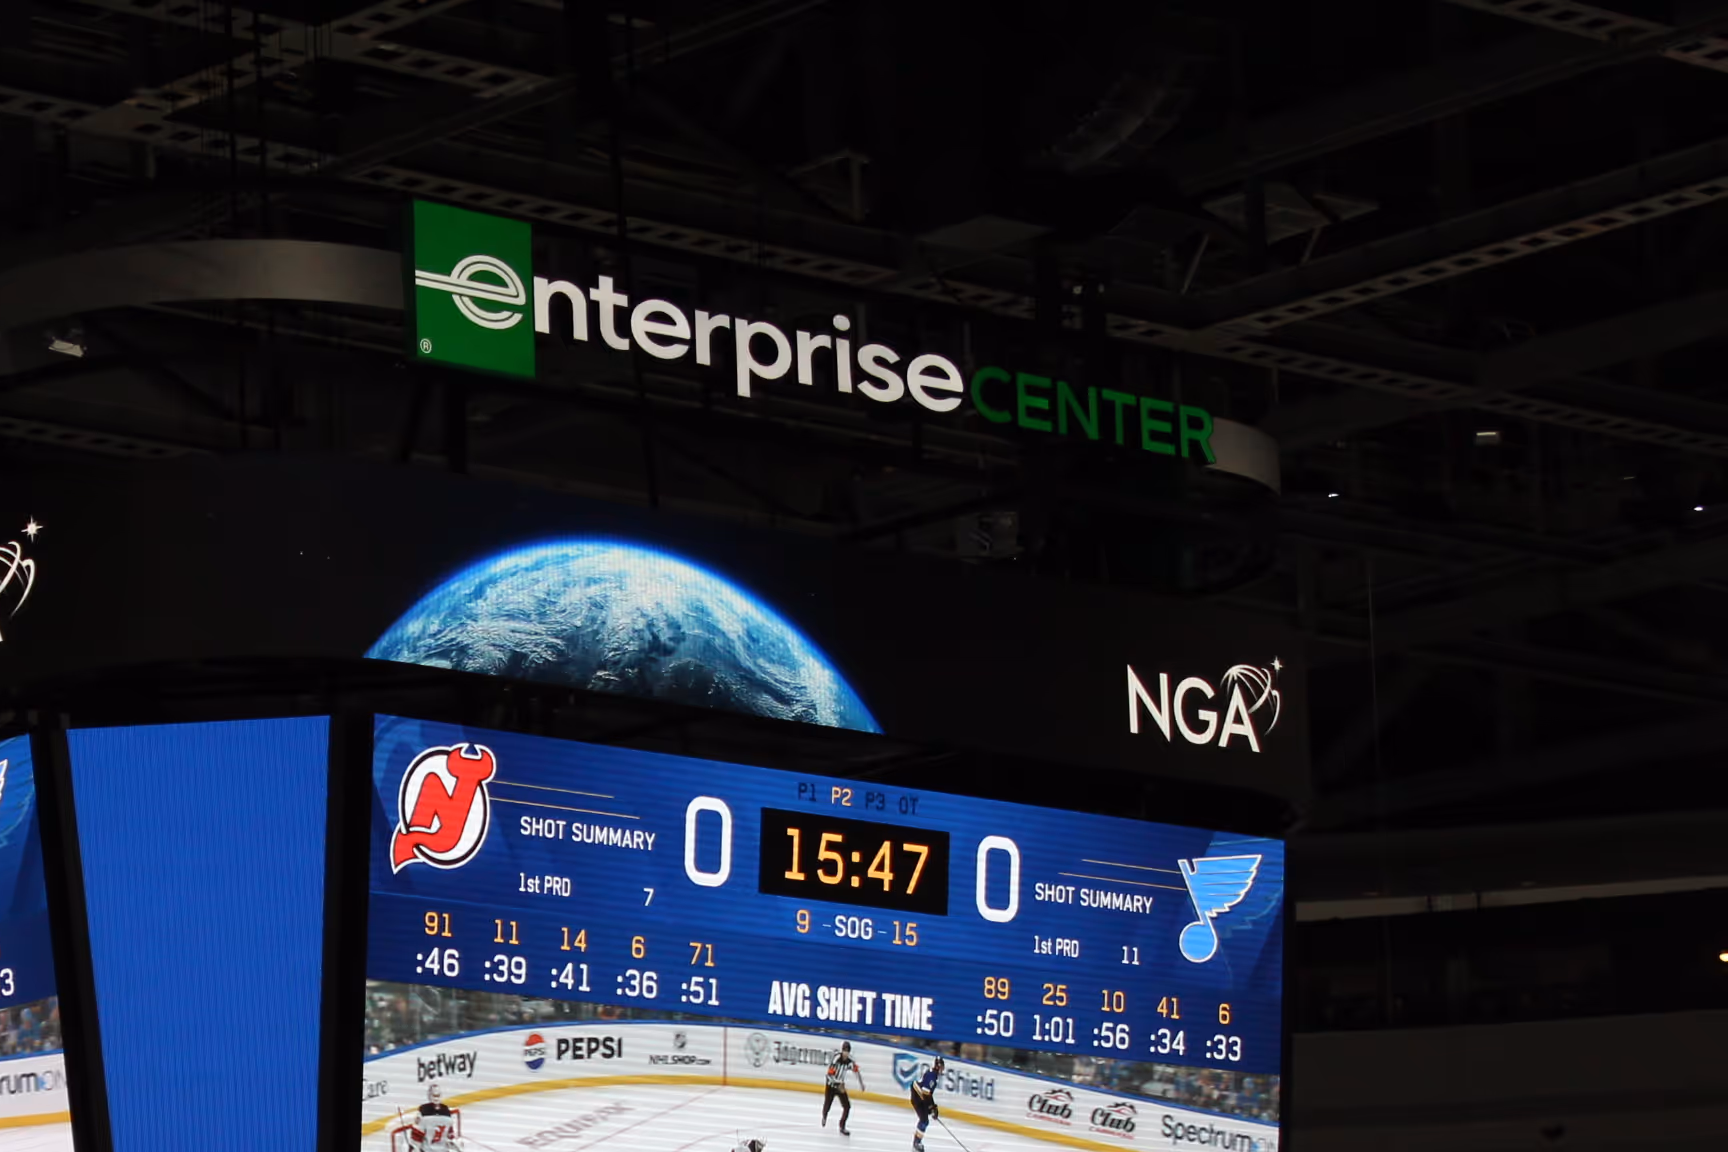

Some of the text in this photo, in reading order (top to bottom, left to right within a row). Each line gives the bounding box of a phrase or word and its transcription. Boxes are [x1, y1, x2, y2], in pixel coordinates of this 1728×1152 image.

[415, 254, 1216, 464] enterprise CENTER
[1127, 664, 1261, 753] NGA
[797, 782, 817, 802] P1
[831, 786, 853, 806] P2
[865, 791, 885, 811] P3
[520, 815, 656, 852] SHOT SUMMARY
[684, 794, 733, 888] 0
[784, 827, 929, 895] 15:47
[975, 834, 1021, 924] 0
[518, 871, 572, 898] 1st PRD
[642, 888, 655, 907] 7
[1034, 881, 1154, 916] SHOT SUMMARY
[423, 912, 716, 968] 91 11 14 6 71
[796, 909, 810, 934] 9
[892, 920, 918, 947] 15
[1033, 934, 1080, 959] 1st PRD
[1121, 945, 1140, 966] 11
[415, 947, 720, 1007] :46 :39 :41 :36 :51
[767, 980, 933, 1032] AVG SHIFT TIME
[983, 976, 1231, 1025] 89 25 10 41 6
[556, 1036, 622, 1060] PEPSI
[975, 1009, 1243, 1062] :50 1:01 :56 :34 :33
[417, 1051, 476, 1082] betway
[1028, 1093, 1072, 1119] Club
[1091, 1107, 1136, 1133] Club
